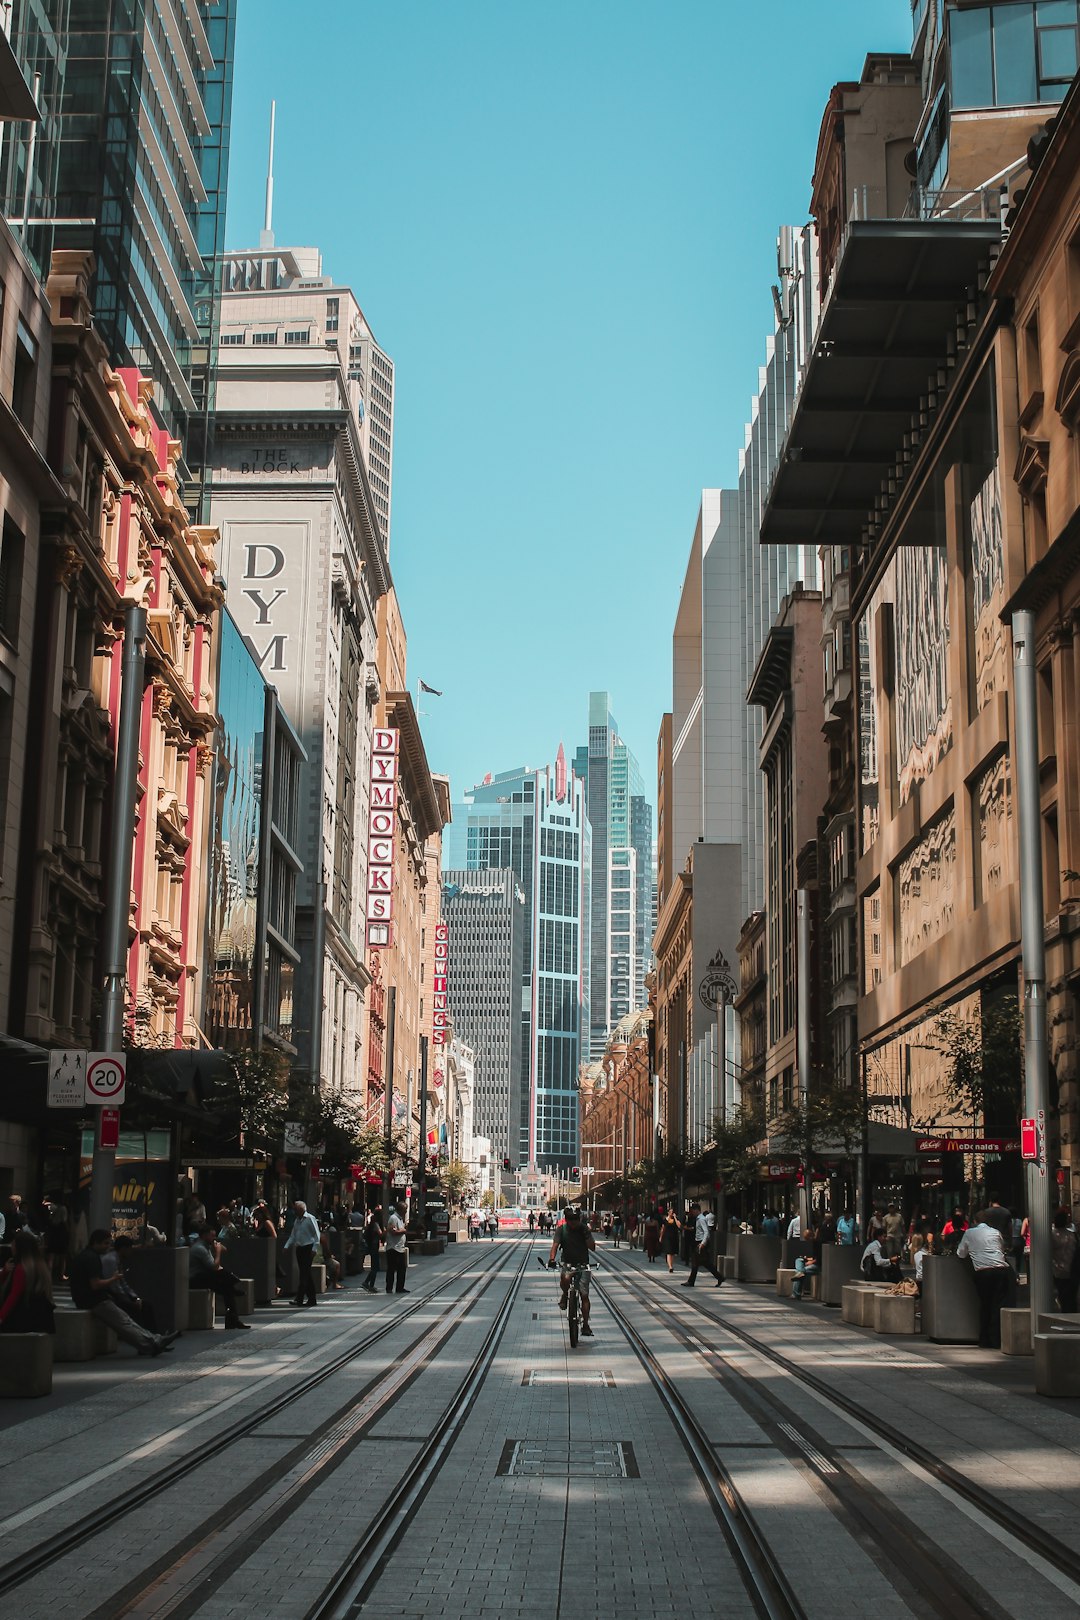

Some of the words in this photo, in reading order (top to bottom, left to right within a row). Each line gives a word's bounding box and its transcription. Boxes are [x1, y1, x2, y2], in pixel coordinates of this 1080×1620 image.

[252, 449, 287, 461] THE
[241, 462, 301, 474] BLOCK
[371, 731, 394, 918] DYMOCKS
[461, 883, 504, 896] Ausgrid
[433, 927, 446, 1043] GOWINGS
[706, 975, 731, 983] HEALTH
[95, 1070, 117, 1086] 20
